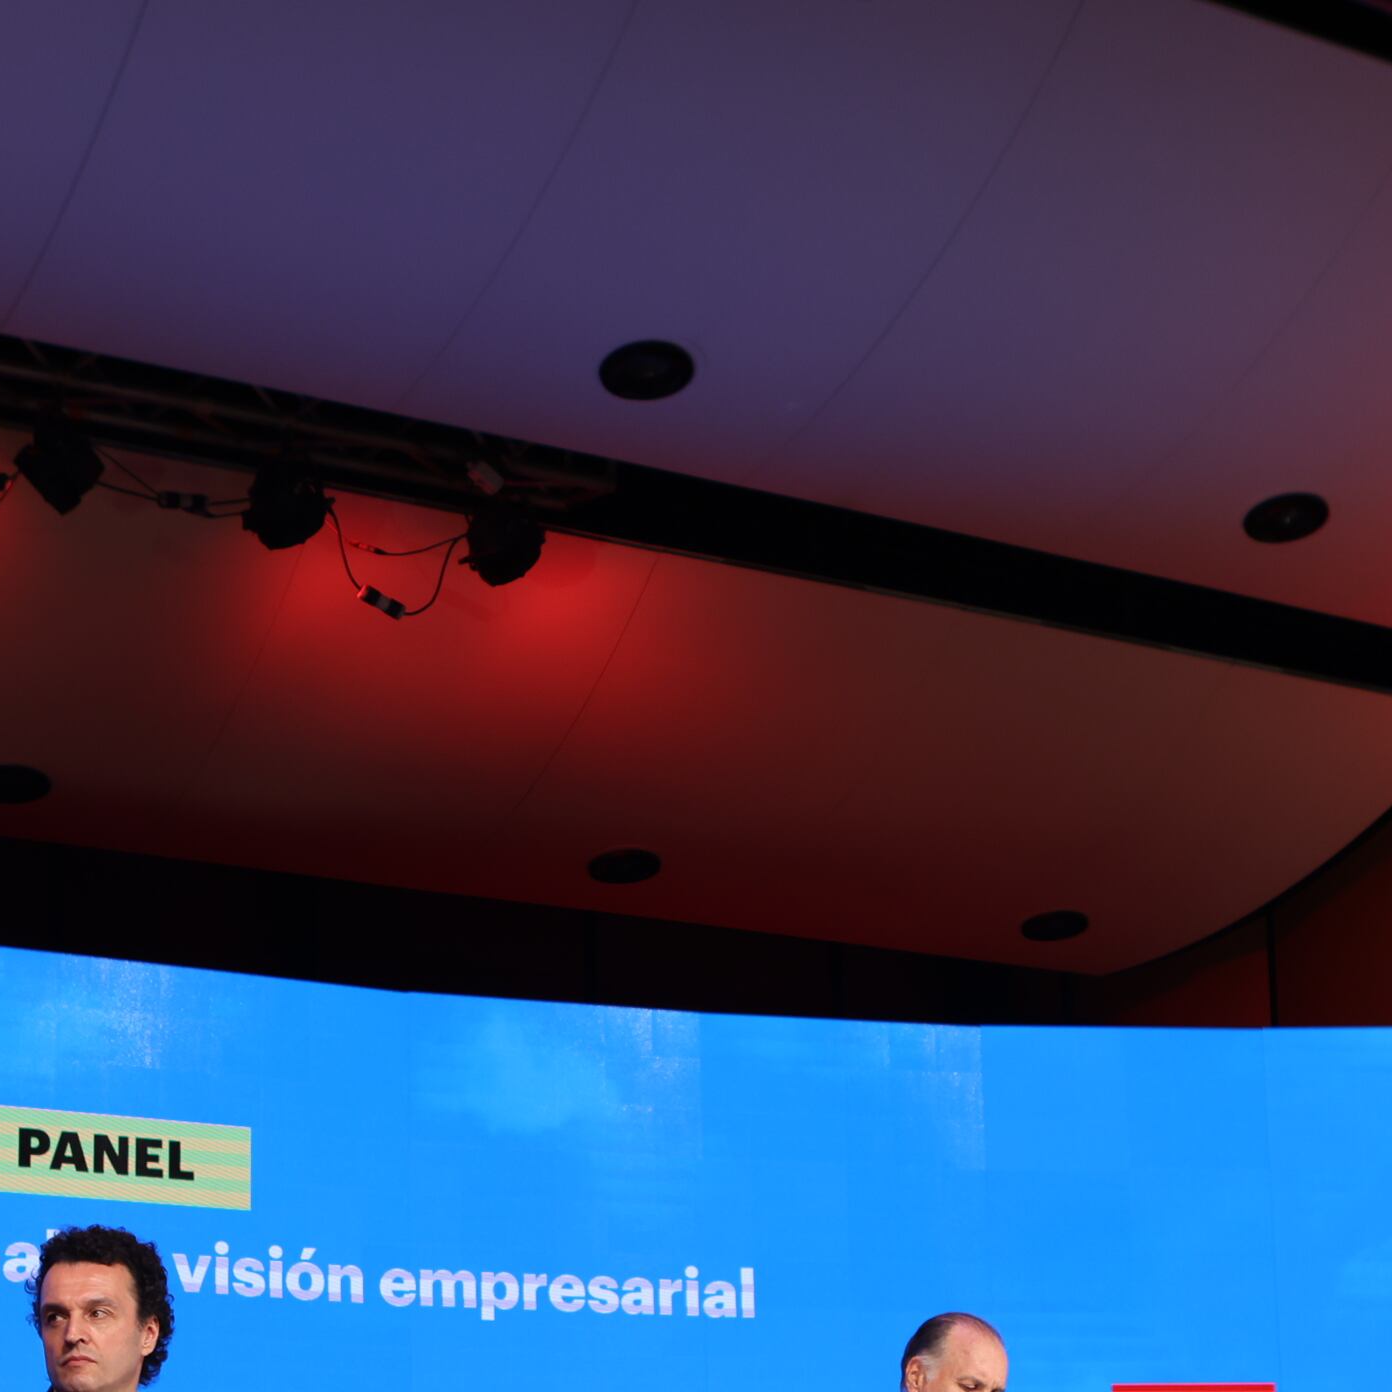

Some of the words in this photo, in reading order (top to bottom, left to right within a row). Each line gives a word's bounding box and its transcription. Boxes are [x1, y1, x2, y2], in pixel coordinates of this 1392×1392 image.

[18, 1127, 195, 1182] PANEL
[172, 1240, 364, 1305] visión
[379, 1265, 756, 1321] empresarial
